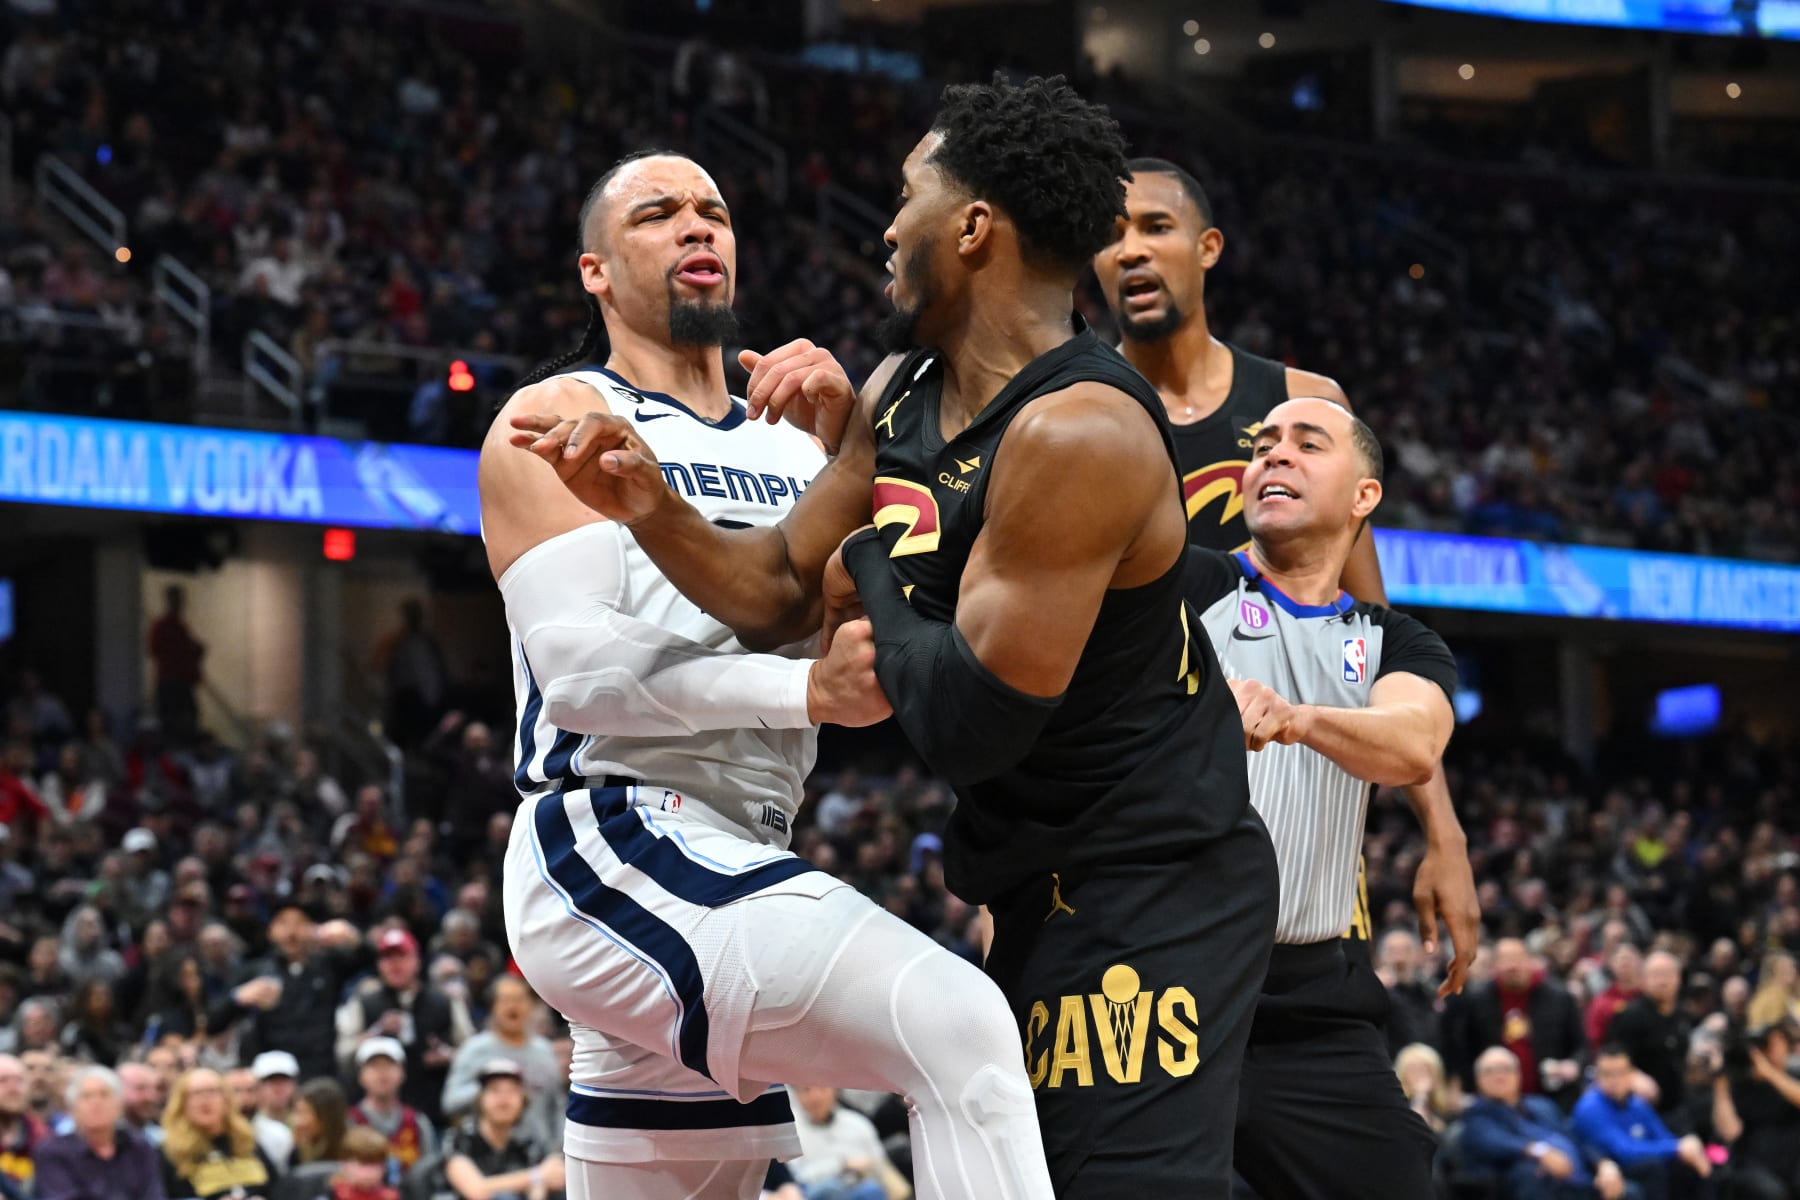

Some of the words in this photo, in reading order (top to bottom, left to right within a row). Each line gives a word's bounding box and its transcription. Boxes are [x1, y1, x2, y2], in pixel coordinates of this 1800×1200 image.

[0, 418, 149, 504] RDAM
[160, 433, 325, 518] VODKA
[1244, 603, 1262, 628] TB
[1027, 985, 1200, 1090] CAVS
